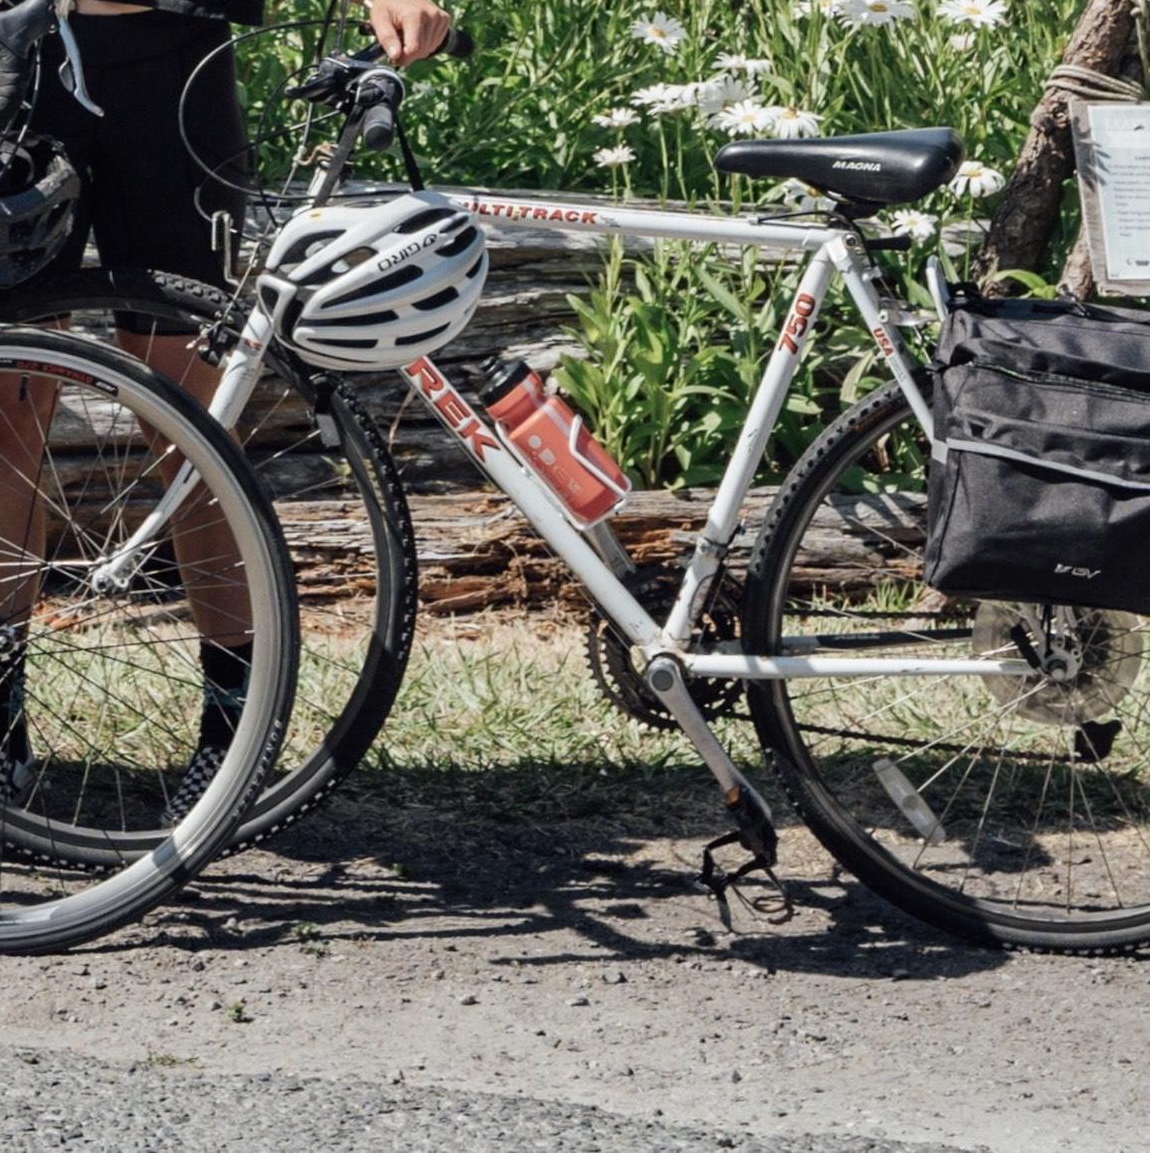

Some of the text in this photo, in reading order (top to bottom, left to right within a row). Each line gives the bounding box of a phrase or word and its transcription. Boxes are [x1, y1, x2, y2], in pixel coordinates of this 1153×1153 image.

[831, 159, 882, 172] MAGNA
[378, 243, 421, 272] GIRO
[779, 293, 816, 355] 750
[873, 326, 895, 358] USA
[406, 358, 501, 463] REK
